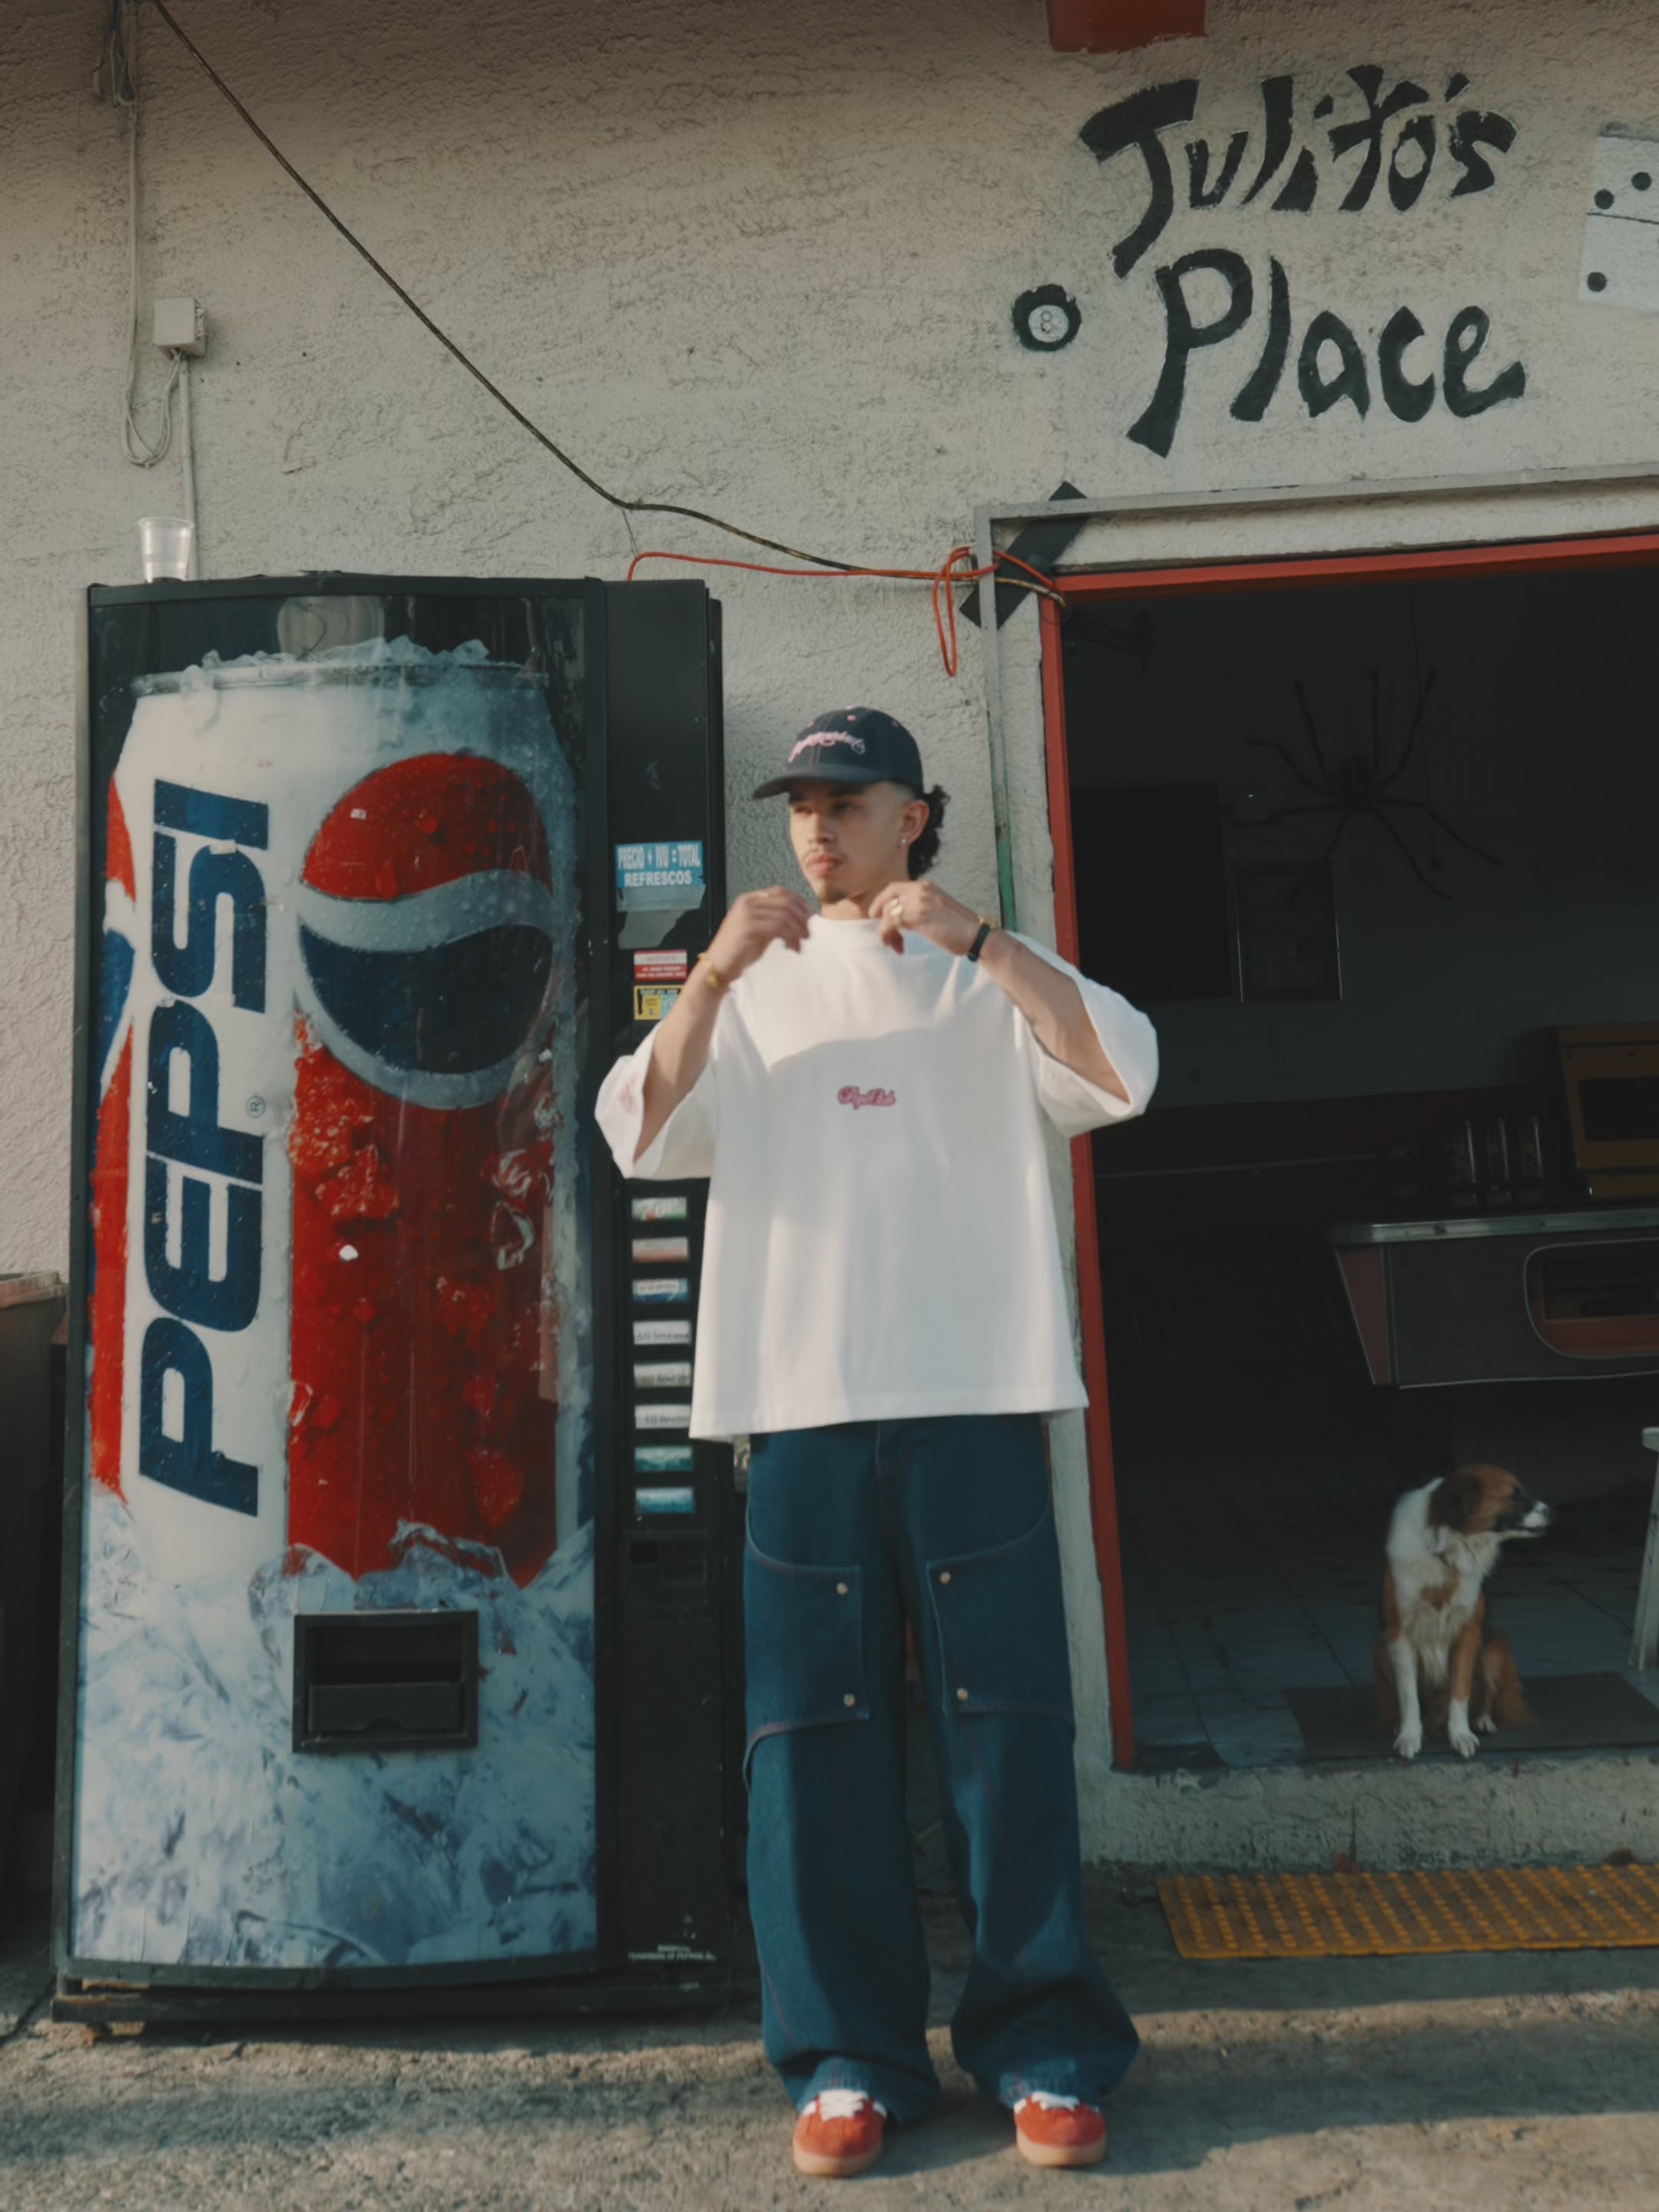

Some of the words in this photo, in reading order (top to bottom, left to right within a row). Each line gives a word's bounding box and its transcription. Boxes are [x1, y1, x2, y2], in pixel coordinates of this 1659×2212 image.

[1079, 65, 1518, 280] Julito's
[1127, 248, 1526, 459] Place
[618, 846, 644, 869] PRECIO
[677, 843, 701, 867] TOTAL
[624, 869, 693, 887] REFRESCOS
[139, 779, 269, 1517] PEPSI
